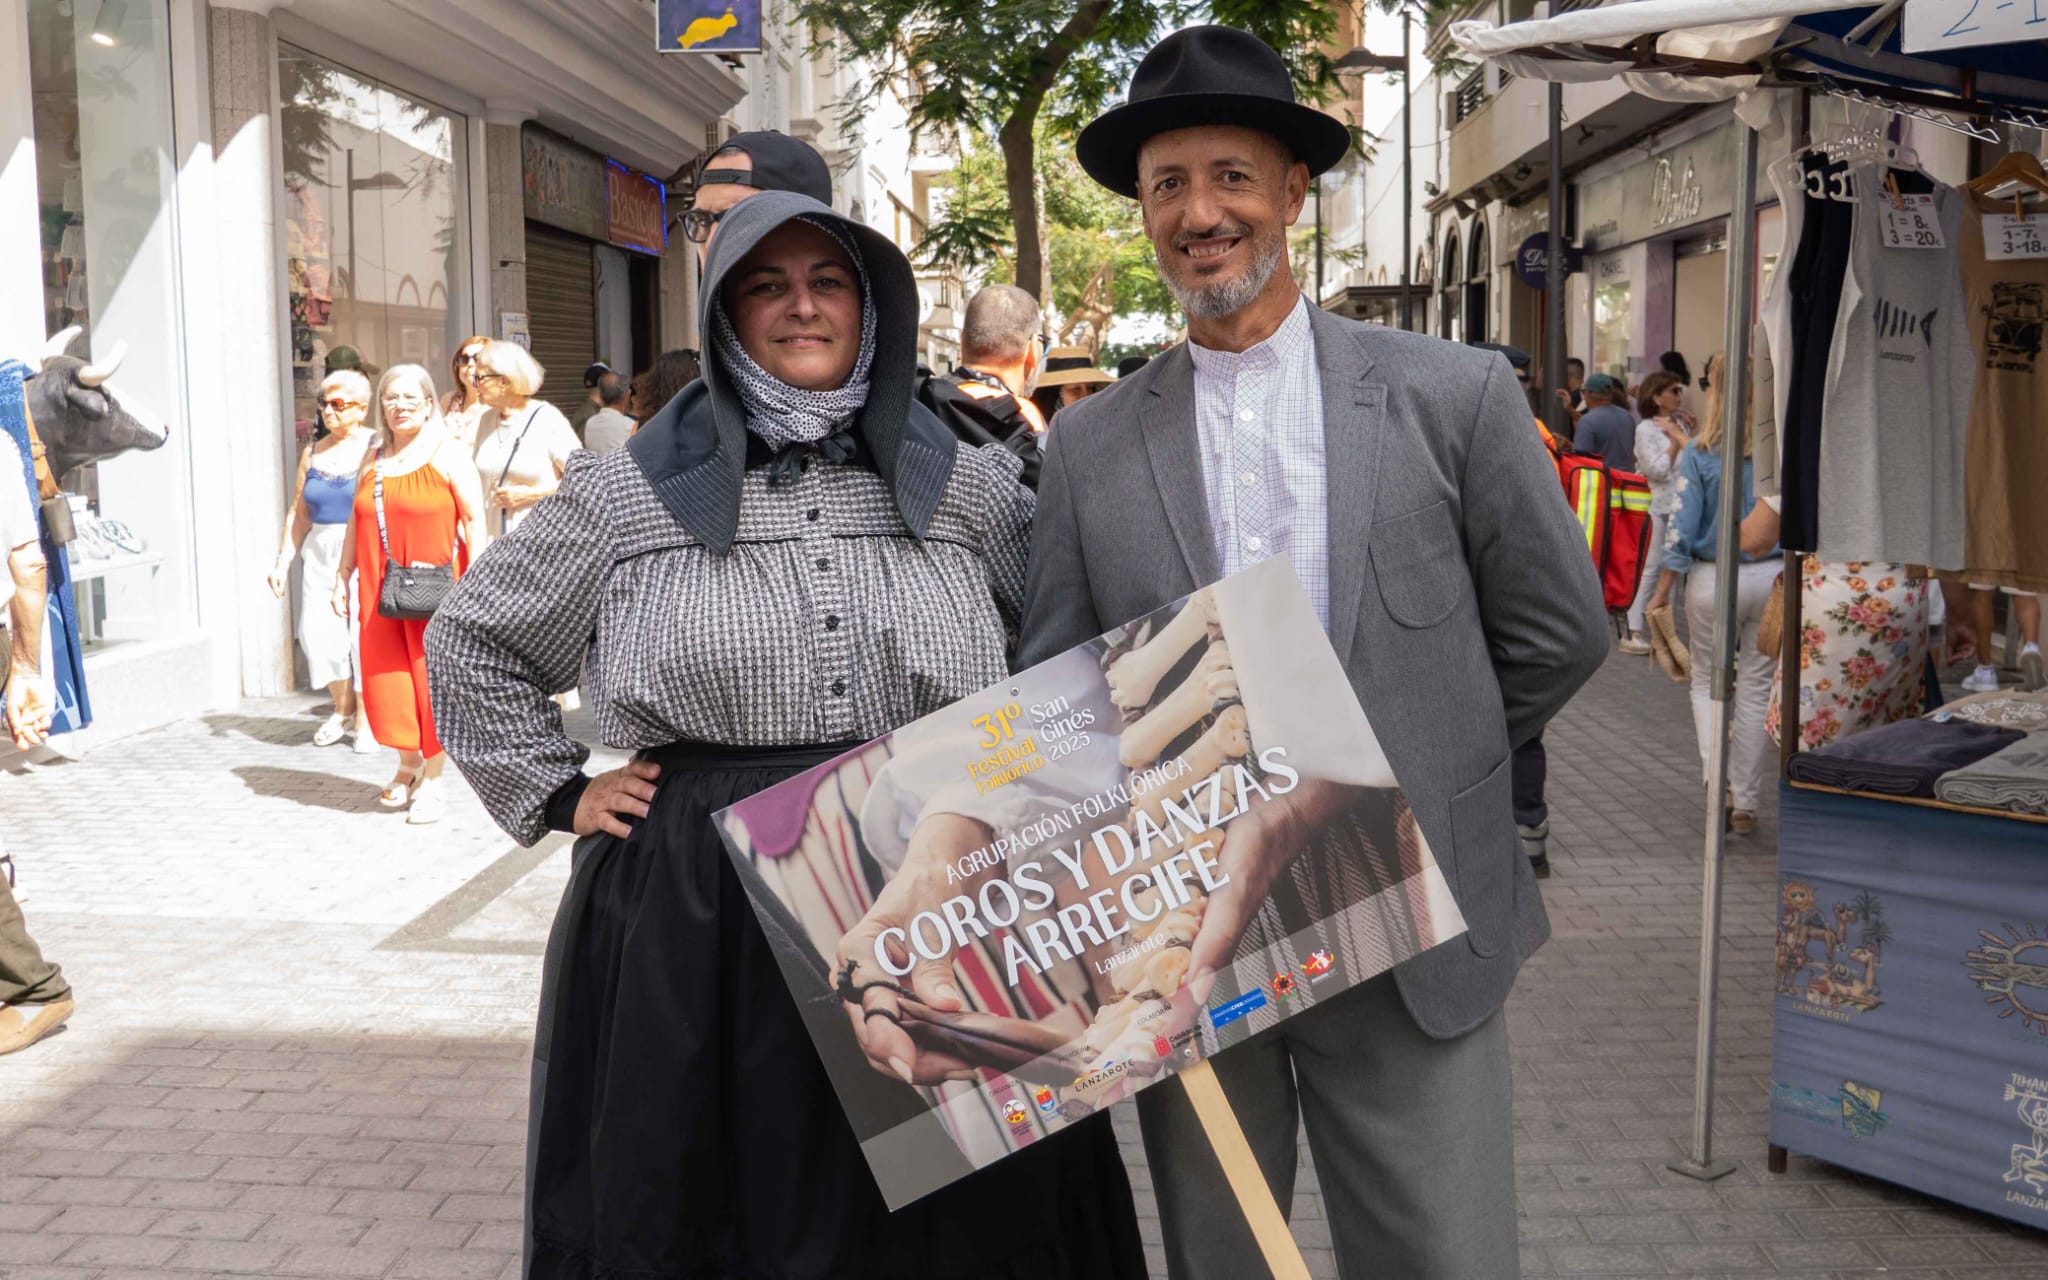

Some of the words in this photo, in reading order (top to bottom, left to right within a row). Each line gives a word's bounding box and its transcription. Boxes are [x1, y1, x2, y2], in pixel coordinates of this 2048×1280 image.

[1030, 695, 1070, 724] San
[1040, 707, 1096, 744] Ginés
[967, 736, 1037, 780] Festival
[1048, 732, 1091, 761] 2025
[975, 755, 1045, 796] Folklórico
[946, 812, 1072, 886] AGRUPACIÓN
[1070, 755, 1193, 833] FOLKLÓRICA
[872, 861, 1057, 978] COROS
[1052, 839, 1090, 891] Y
[1091, 745, 1300, 877] DANZAS
[999, 839, 1231, 988] ARRECIFE
[1094, 931, 1167, 976] Lanzarote
[1074, 1057, 1136, 1093] LANZAROTE
